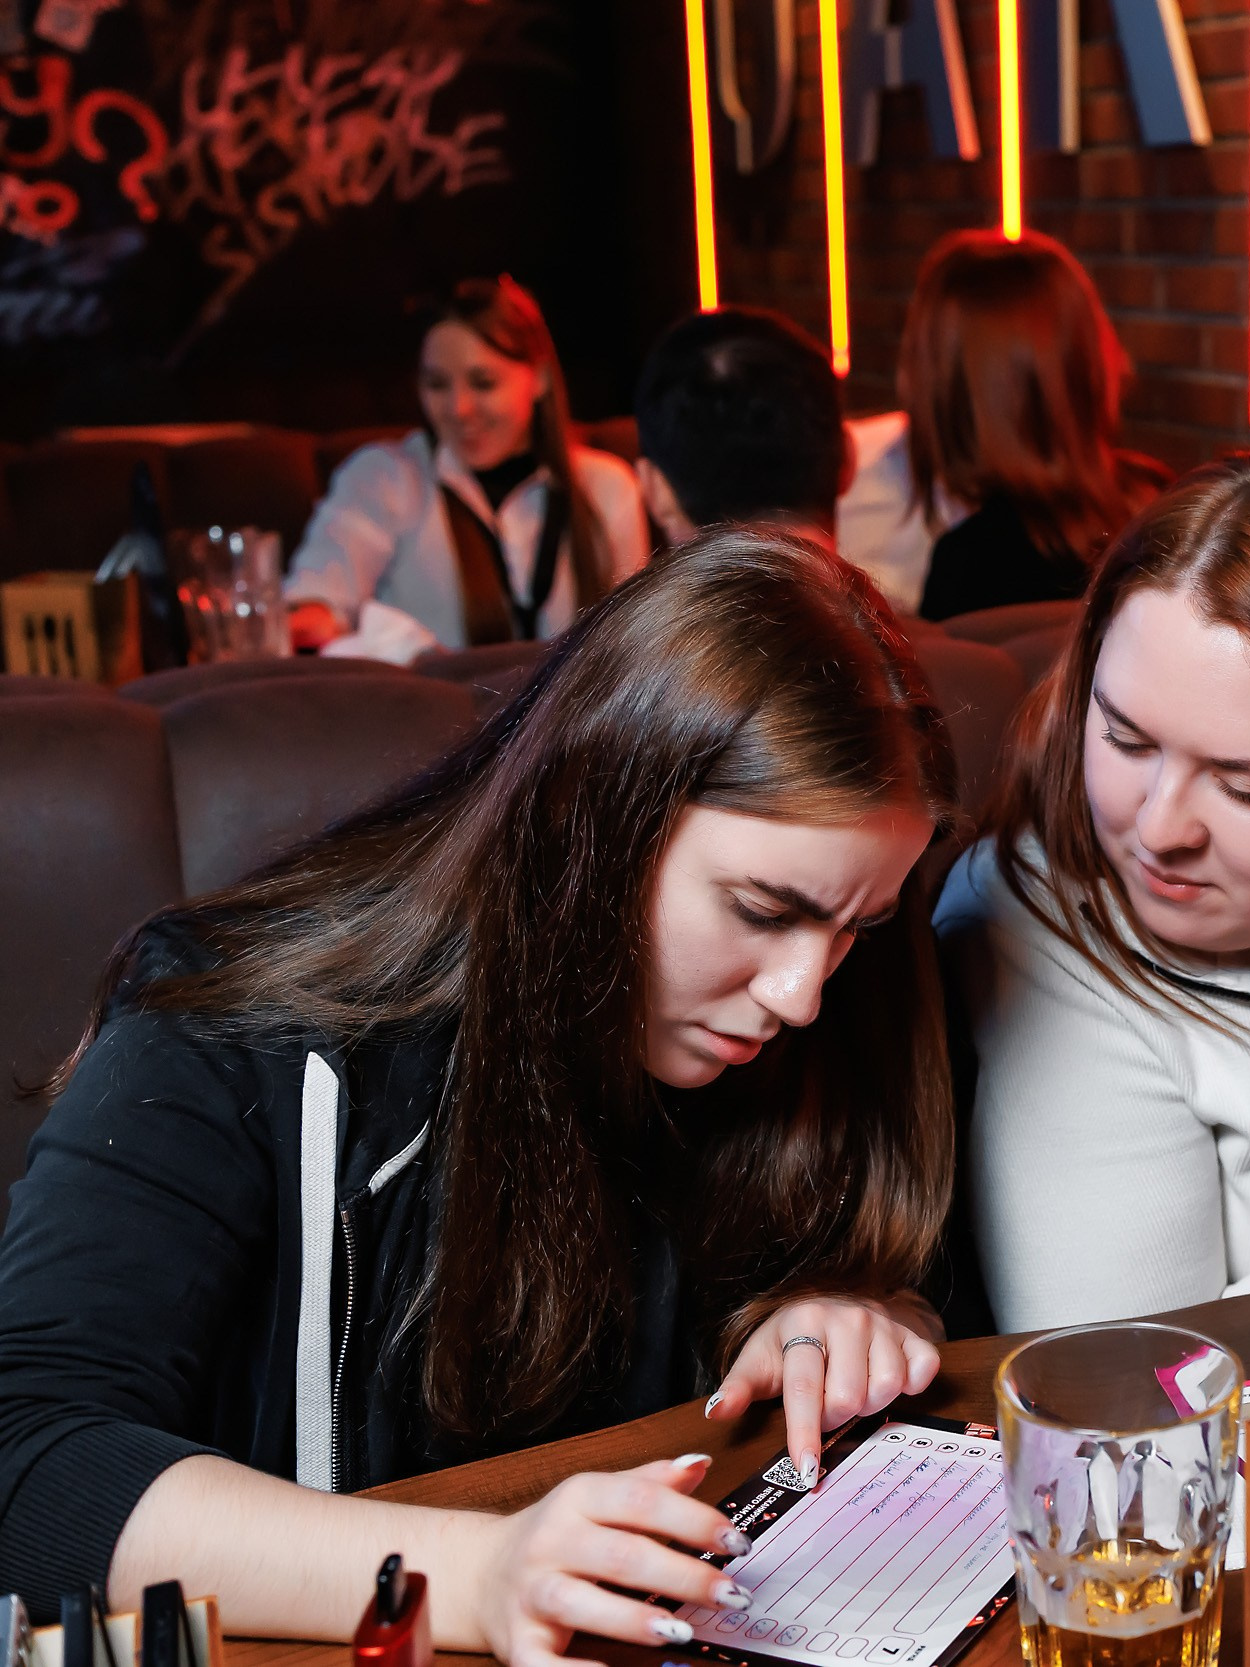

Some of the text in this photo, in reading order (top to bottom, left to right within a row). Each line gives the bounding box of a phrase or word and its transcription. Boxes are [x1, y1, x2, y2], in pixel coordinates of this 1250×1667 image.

[741, 1486, 775, 1515] НЕЧЕГО ТАМ
[773, 1489, 785, 1498] НЕ
[740, 1496, 777, 1528] СКАНИРУЙТЕ
[882, 1647, 900, 1655] 7
